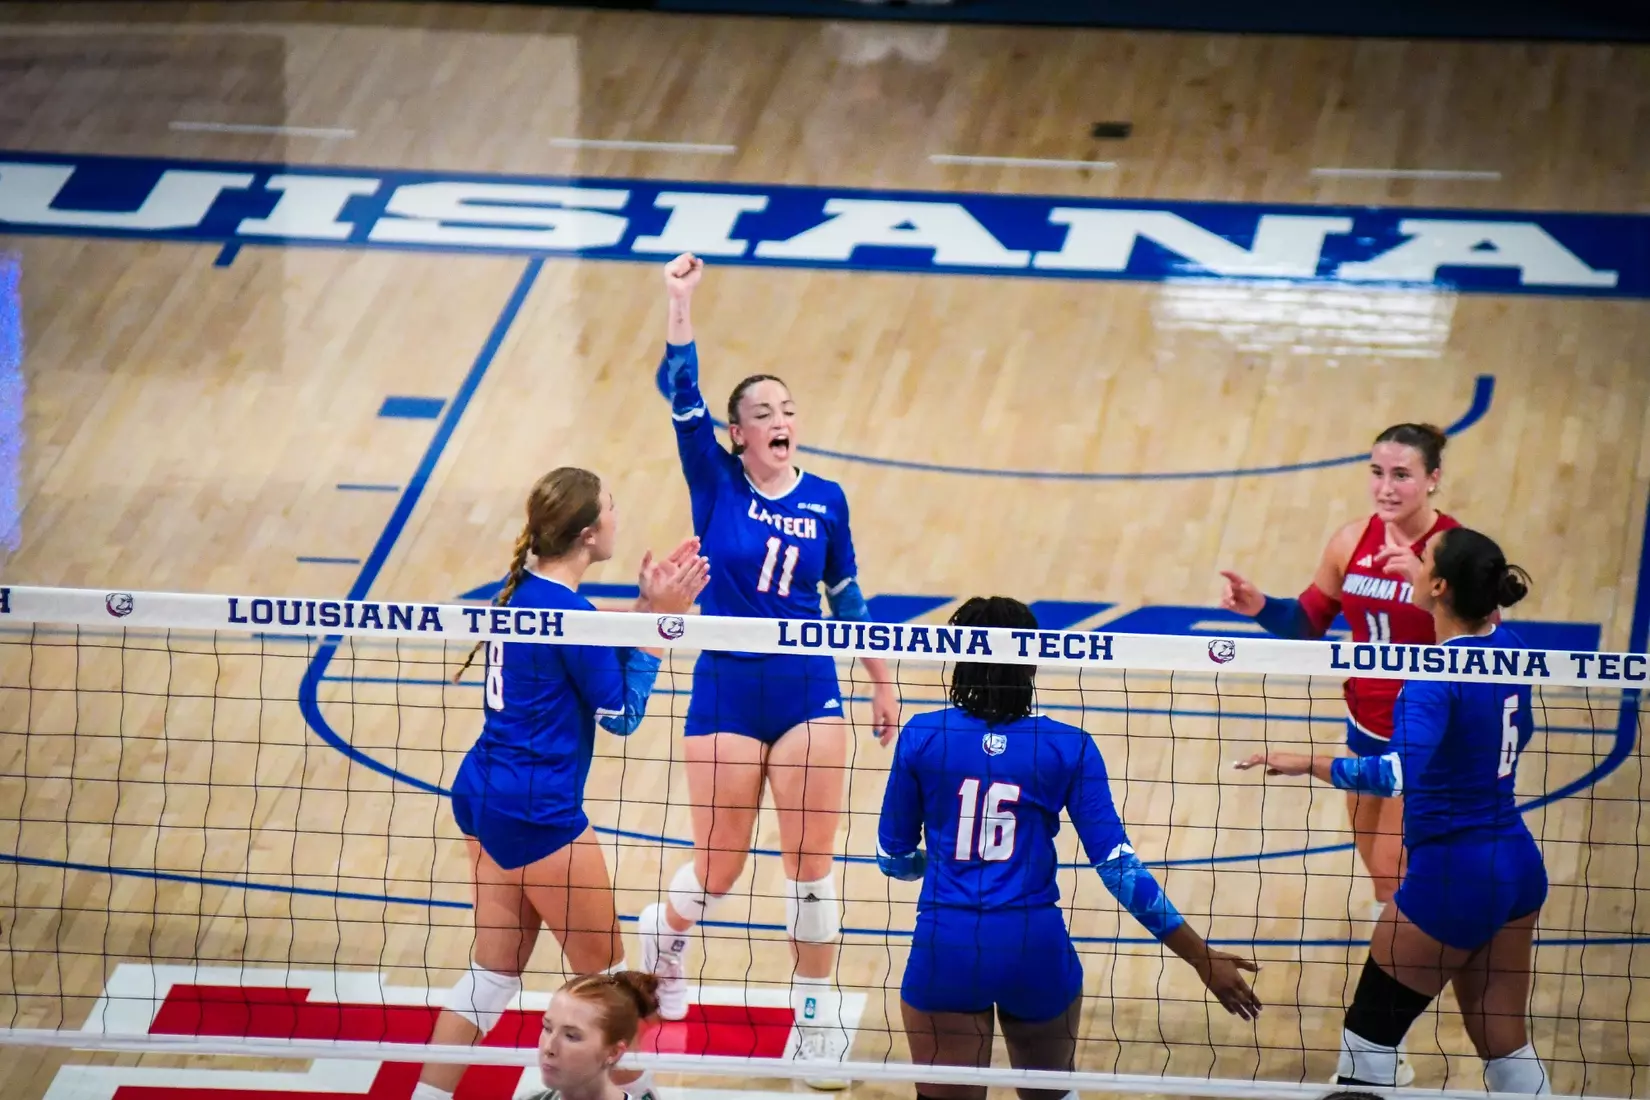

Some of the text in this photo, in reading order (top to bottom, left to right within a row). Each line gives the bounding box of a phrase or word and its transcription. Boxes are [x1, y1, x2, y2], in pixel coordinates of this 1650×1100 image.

[757, 535, 800, 598] 11
[228, 597, 564, 637] LOUISIANA TECH
[778, 621, 1114, 660] LOUISIANA TECH
[486, 641, 504, 712] 8
[1330, 643, 1647, 681] LOUISIANA TEC
[1498, 694, 1520, 779] 6
[955, 778, 1020, 861] 16
